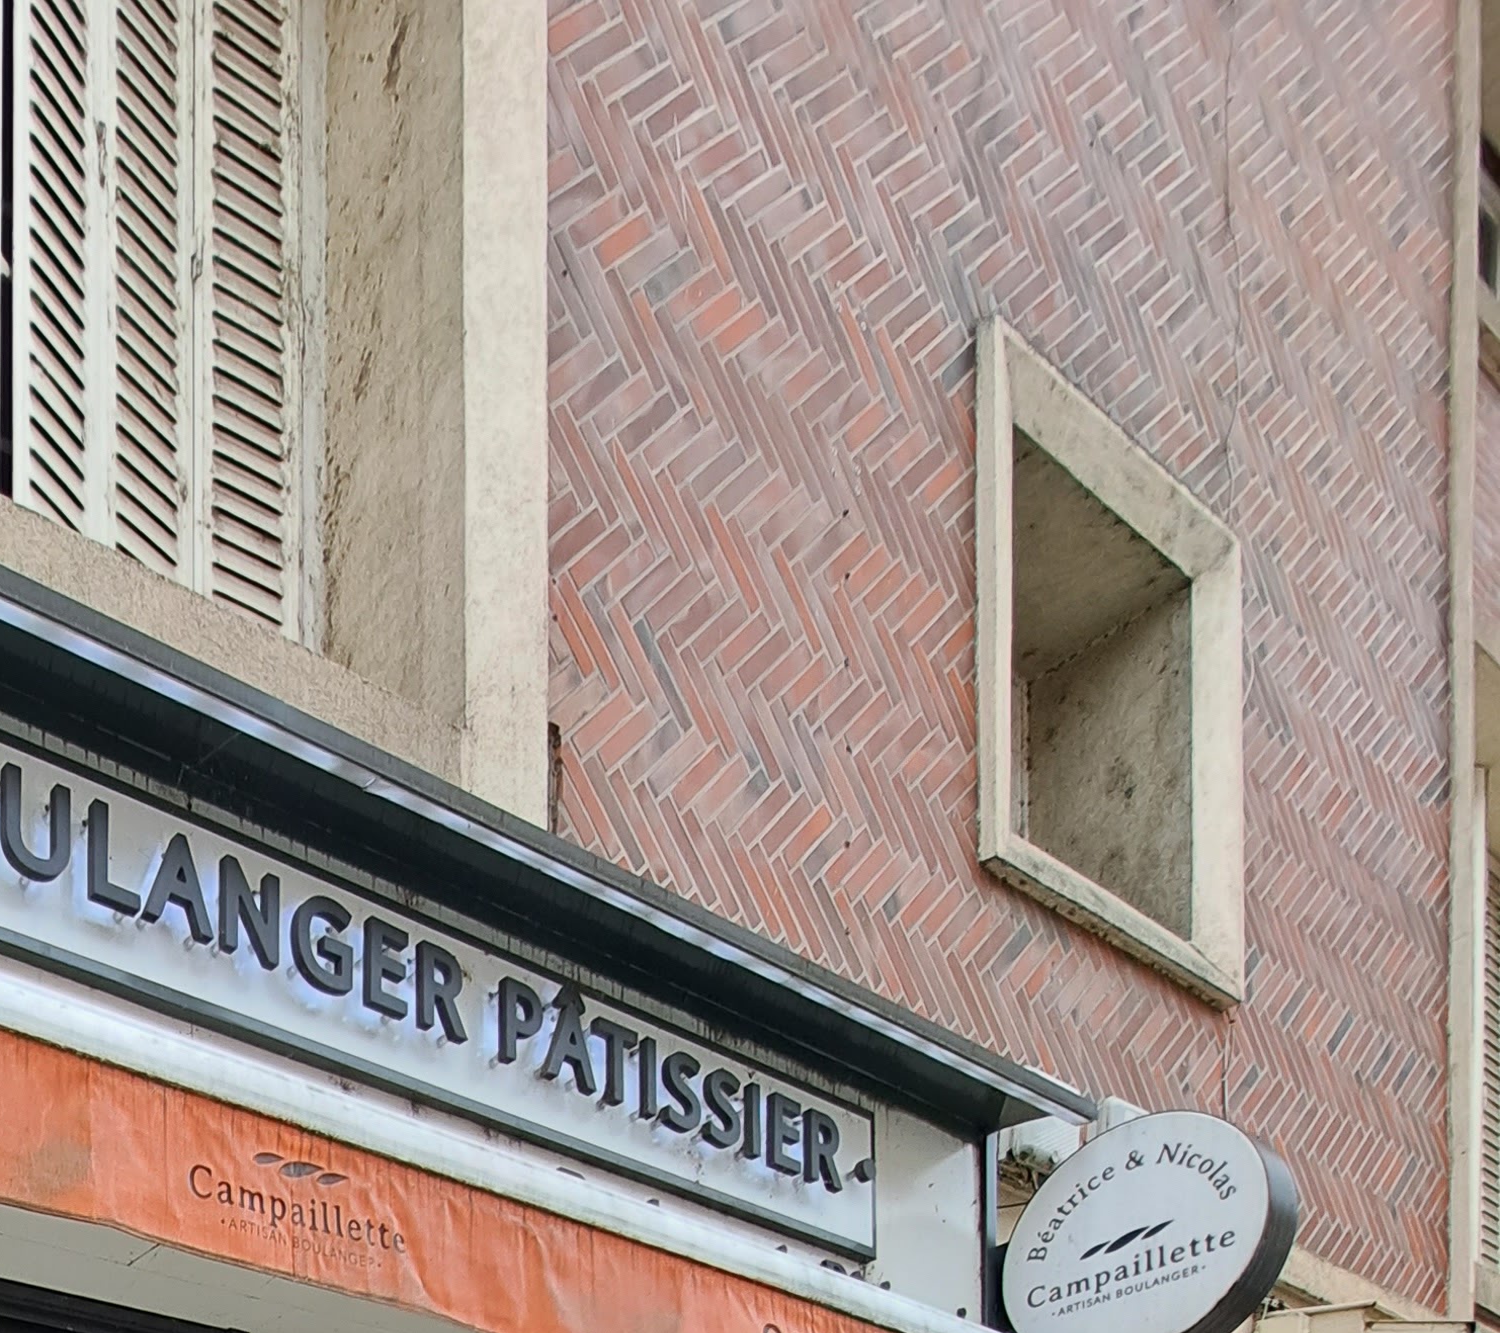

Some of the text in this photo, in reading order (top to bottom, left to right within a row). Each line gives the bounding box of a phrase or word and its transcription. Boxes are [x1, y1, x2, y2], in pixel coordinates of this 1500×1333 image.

[498, 978, 843, 1192] PÂTISSIER
[189, 1165, 406, 1253] Campaillette
[228, 1217, 288, 1248] ARTISAN
[1026, 1142, 1237, 1262] Béatrice & Nicolas
[1026, 1230, 1236, 1309] Campaillette
[1057, 1265, 1199, 1317] ARTISAN BOULANGER
